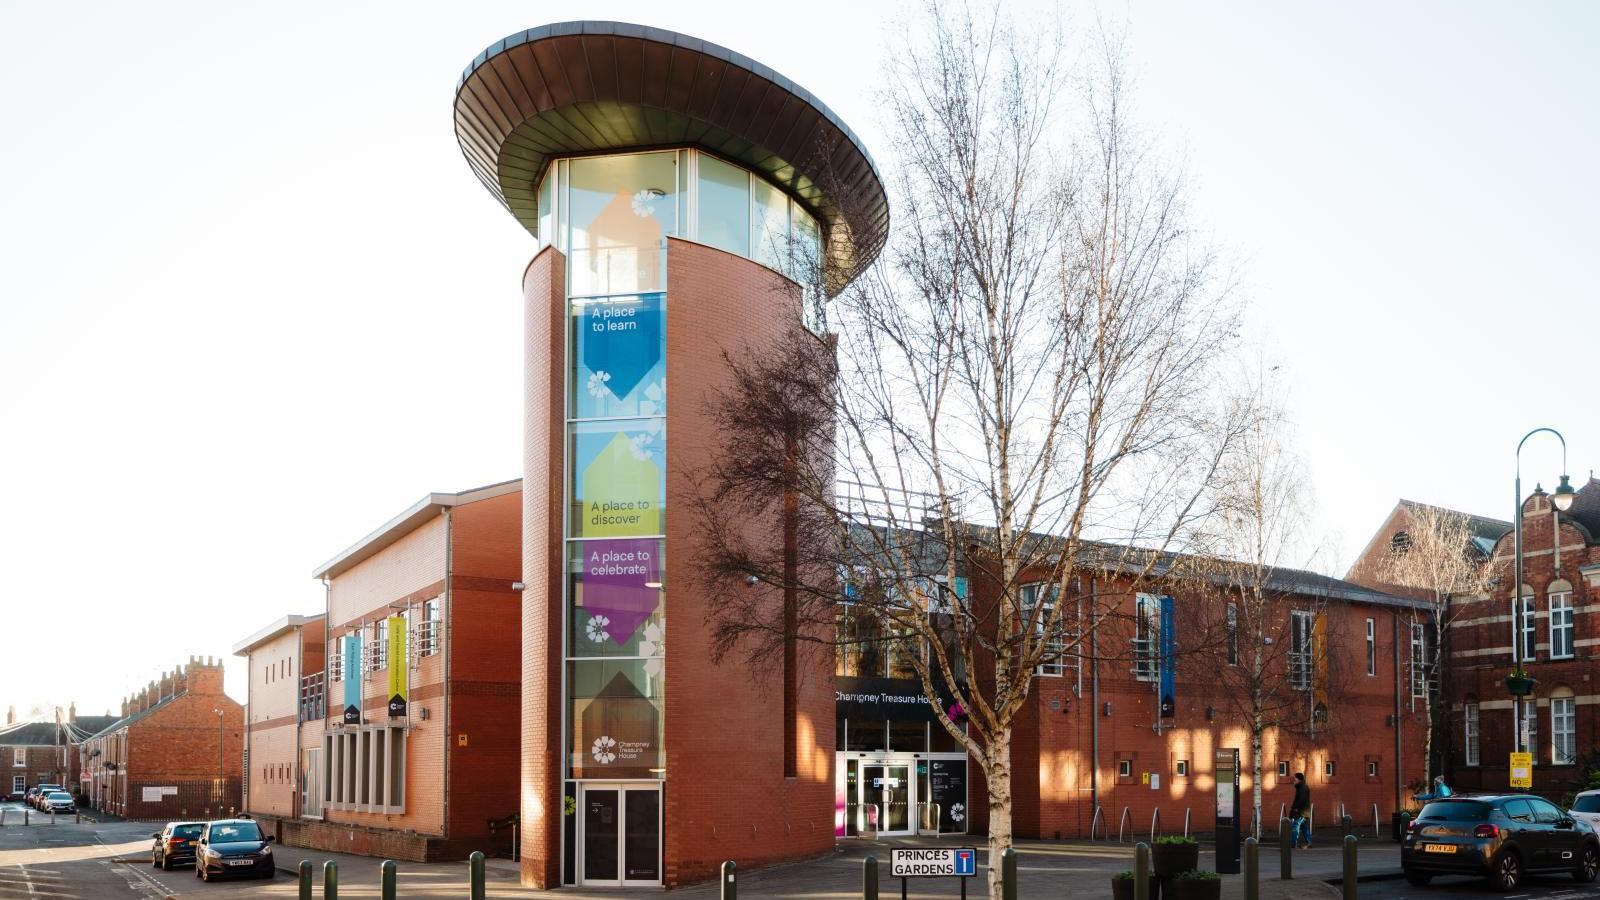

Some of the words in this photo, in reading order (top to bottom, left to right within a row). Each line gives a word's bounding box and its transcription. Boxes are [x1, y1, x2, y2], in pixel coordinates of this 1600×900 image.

[592, 308, 600, 318] A
[603, 306, 635, 320] place
[592, 322, 604, 332] to
[607, 320, 637, 331] learn
[591, 502, 600, 512] A
[602, 500, 634, 513] place
[638, 500, 650, 510] to
[591, 514, 641, 526] discover
[591, 551, 600, 562] A
[602, 550, 635, 564] place
[637, 550, 650, 561] to
[591, 564, 647, 576] celebrate
[835, 691, 879, 704] Champney
[881, 693, 915, 703] Treasure
[897, 850, 949, 861] PRINCES
[895, 864, 953, 874] GARDENS
